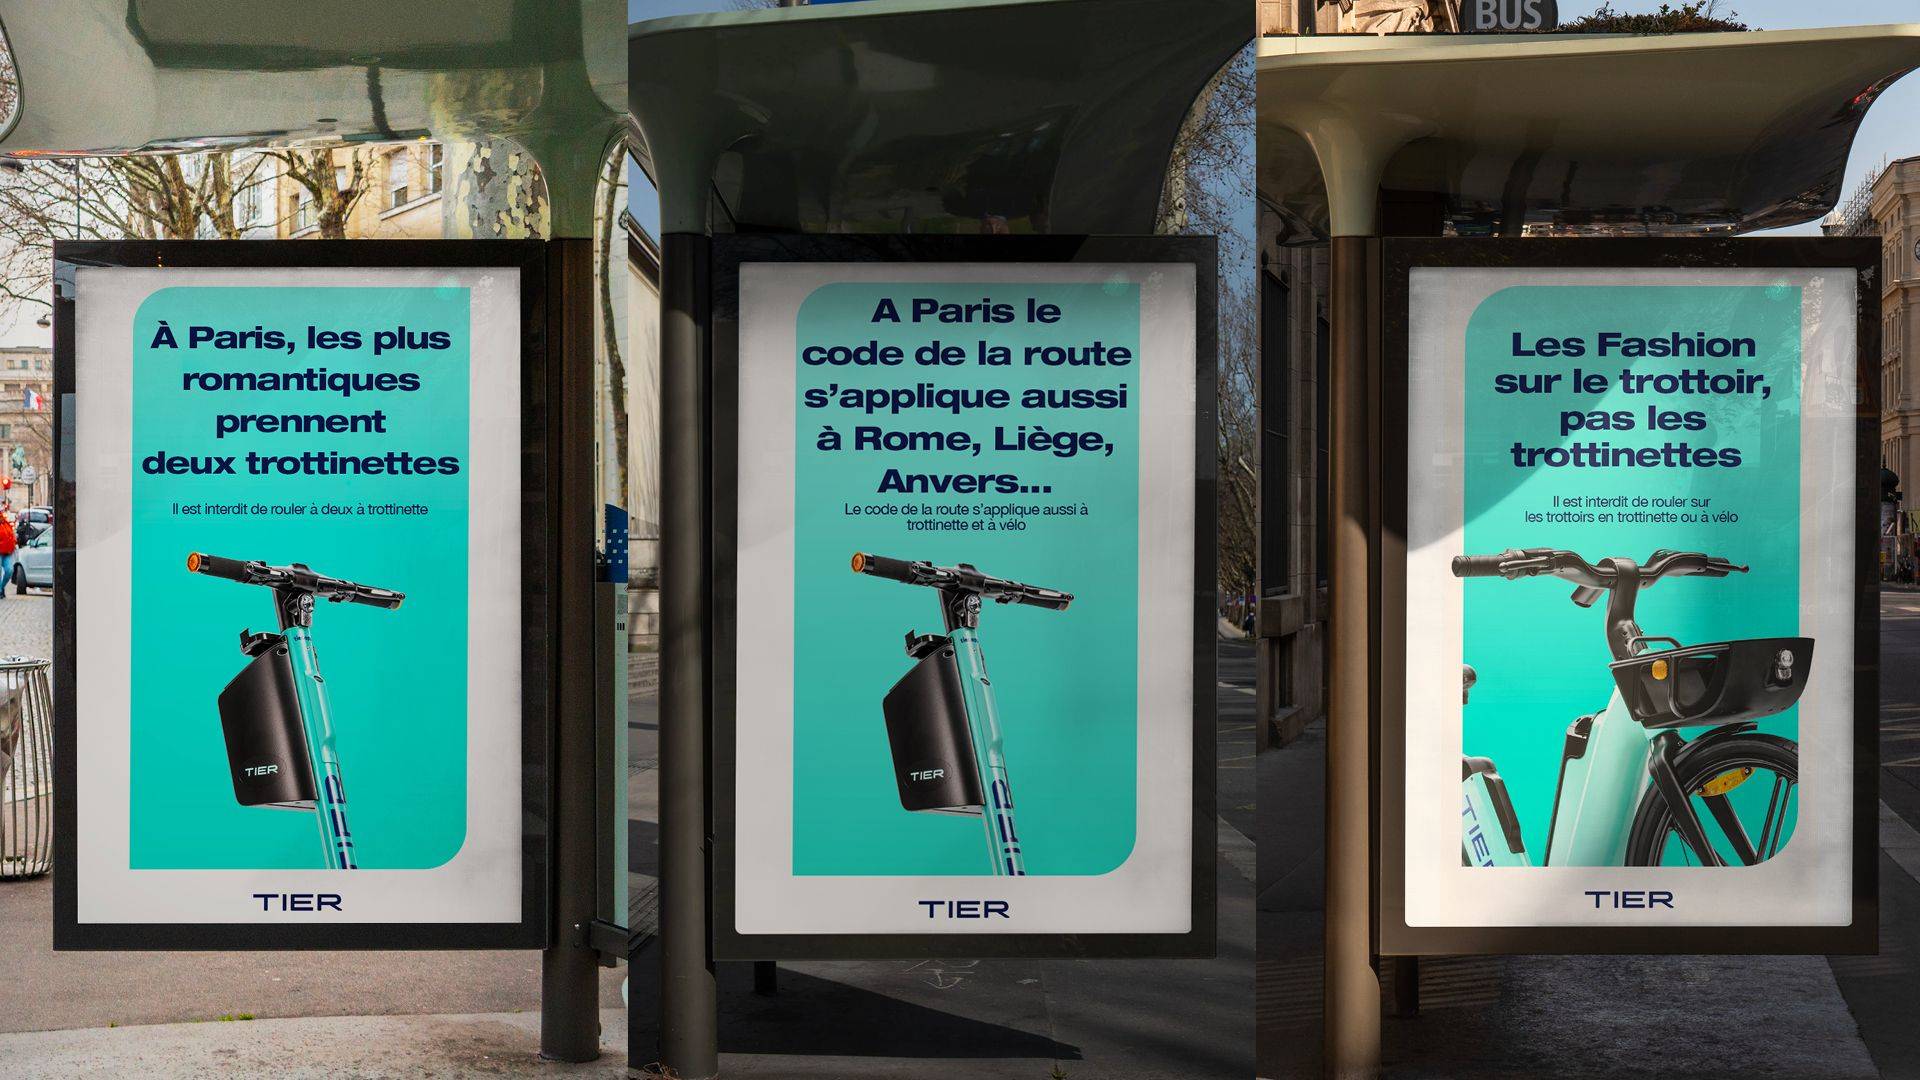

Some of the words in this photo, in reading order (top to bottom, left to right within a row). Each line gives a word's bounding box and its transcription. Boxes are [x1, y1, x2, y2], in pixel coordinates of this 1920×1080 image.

[1475, 0, 1542, 30] BUS
[871, 298, 901, 323] A
[912, 298, 1016, 324] Paris
[1027, 298, 1062, 324] le
[151, 320, 178, 349] À
[189, 325, 296, 355] Paris,
[308, 325, 362, 350] les
[374, 325, 451, 356] plus
[1512, 332, 1586, 357] Les
[1598, 331, 1757, 358] Fashion
[802, 340, 905, 367] code
[914, 340, 966, 367] de
[978, 340, 1012, 367] la
[1024, 341, 1132, 367] route
[183, 367, 421, 398] romantiques
[1494, 373, 1562, 394] sur
[1574, 368, 1609, 394] le
[1619, 368, 1772, 400] trottoir,
[803, 383, 1011, 415] s’applique
[1021, 383, 1128, 409] aussi
[215, 409, 386, 439] prennent
[1560, 409, 1635, 436] pas
[1648, 405, 1707, 431] les
[816, 425, 842, 451] à
[855, 426, 981, 457] Rome,
[995, 425, 1115, 459] Liège,
[1510, 441, 1742, 468] trottinettes
[142, 450, 236, 476] deux
[247, 450, 460, 476] trottinettes
[877, 468, 1052, 494] Anvers...
[172, 502, 179, 515] Il
[182, 503, 202, 515] est
[205, 502, 248, 515] interdit
[251, 502, 268, 515] de
[271, 502, 307, 515] rouler
[310, 502, 318, 515] à
[321, 502, 353, 515] deux
[357, 502, 365, 515] à
[368, 503, 429, 515] trottinette
[845, 503, 861, 515] Le
[865, 503, 898, 515] code
[901, 503, 918, 515] de
[921, 503, 932, 515] la
[936, 503, 969, 515] route
[972, 503, 1040, 518] s’applique
[1042, 503, 1077, 515] aussi
[1080, 502, 1089, 515] à
[1553, 496, 1560, 508] Il
[1562, 496, 1582, 508] est
[1585, 496, 1628, 508] interdit
[1631, 496, 1649, 508] de
[1651, 496, 1688, 508] rouler
[1690, 498, 1711, 508] sur
[907, 519, 969, 531] trottinette
[971, 519, 985, 531] et
[988, 518, 996, 531] à
[999, 518, 1027, 531] vélo
[1525, 511, 1543, 523] les
[1546, 511, 1595, 523] trottoirs
[1598, 513, 1614, 523] en
[1617, 511, 1678, 523] trottinette
[1680, 513, 1698, 523] ou
[1700, 510, 1709, 523] à
[1711, 510, 1739, 523] vélo
[245, 764, 278, 778] TIER
[910, 768, 944, 782] TIER
[253, 893, 343, 912] TIER
[918, 901, 1011, 919] TIER
[1585, 891, 1675, 909] TIER
